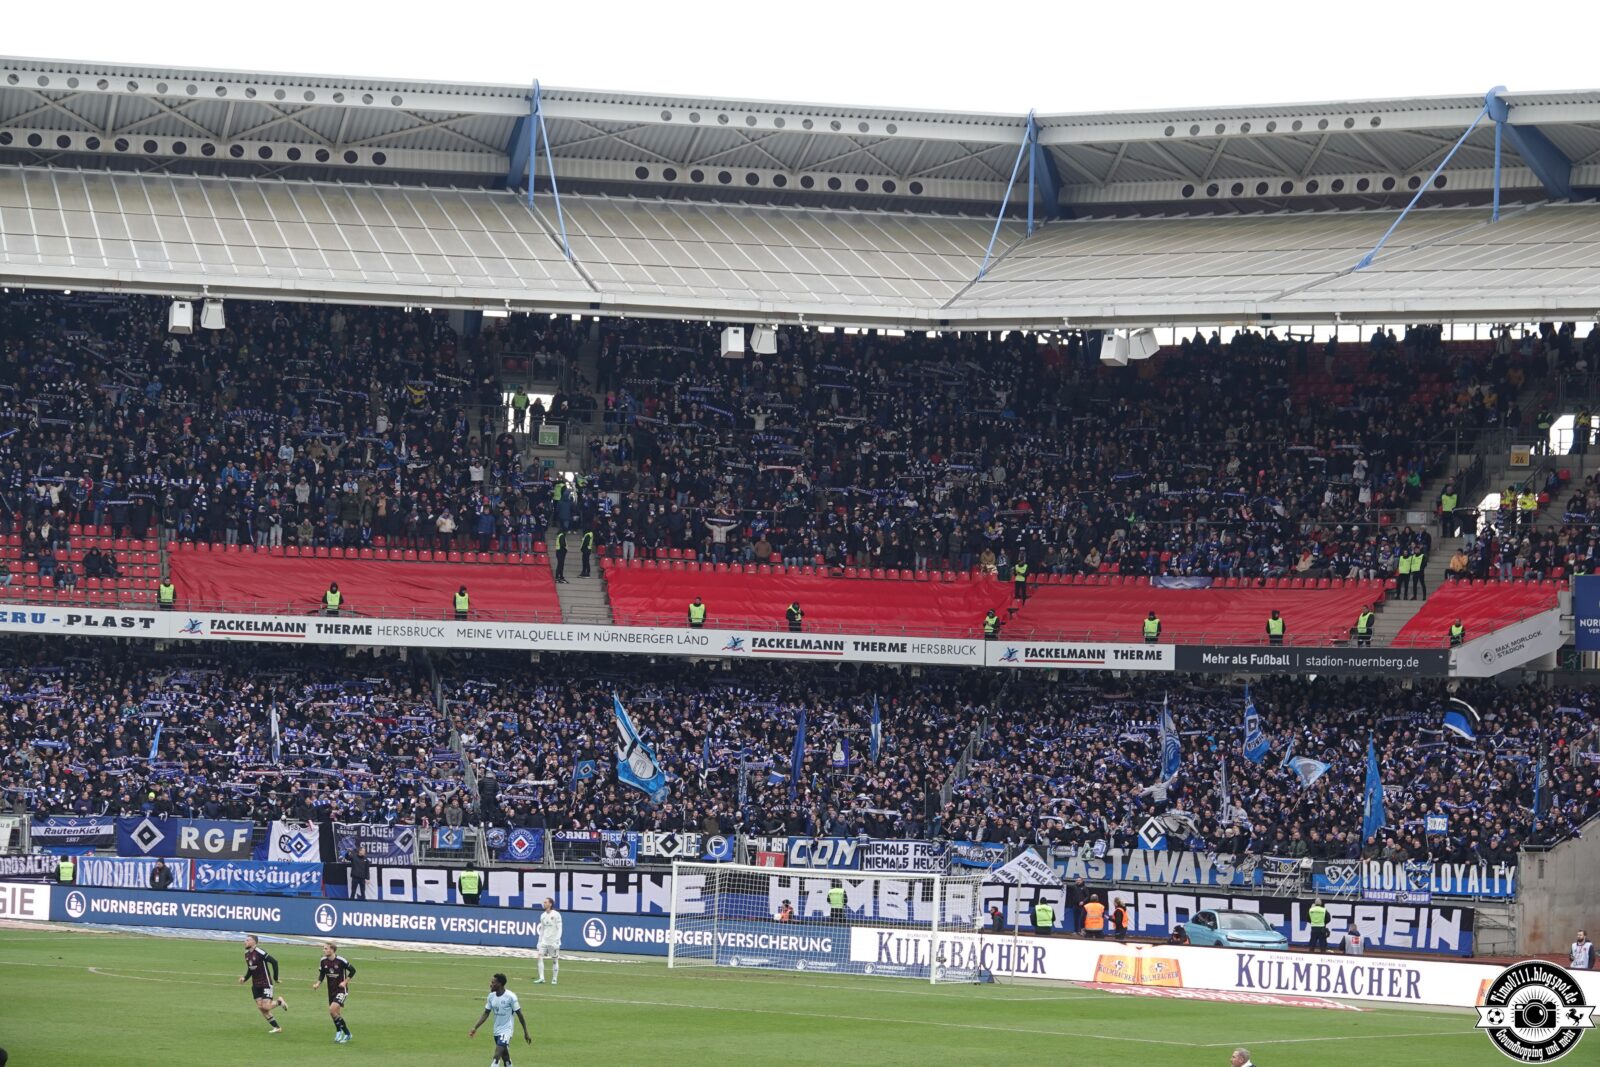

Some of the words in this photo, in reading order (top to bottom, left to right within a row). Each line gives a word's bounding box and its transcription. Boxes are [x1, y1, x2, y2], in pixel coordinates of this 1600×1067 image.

[67, 614, 155, 629] PLAST
[1579, 618, 1600, 627] NÜR
[210, 619, 306, 633] FACKELMANN
[315, 623, 372, 636] THERME
[377, 626, 445, 638] HERSBRUCK
[456, 628, 493, 639] MEINE
[496, 629, 573, 642] VITALQUELLE
[577, 632, 590, 642] IM
[593, 630, 674, 645] NÜRNBERGER
[677, 633, 709, 646] LAND
[1495, 643, 1509, 653] MAX
[1510, 630, 1543, 649] MORLOCK
[751, 637, 844, 651] FACKELMANN
[853, 640, 907, 653] THERME
[912, 643, 977, 656] HERSBRUCK
[1024, 647, 1105, 660] FACKELMANN
[1113, 649, 1162, 661] THERME
[1497, 644, 1525, 658] STADION
[1202, 653, 1229, 665] Mehr
[1232, 654, 1248, 665] als
[1250, 654, 1290, 666] Fußball
[1305, 655, 1419, 670] stadion-nuernberg.de
[44, 826, 101, 835] RautenKick
[866, 843, 909, 856] NIEMALS
[865, 857, 909, 870] NIEMALS
[196, 863, 321, 889] Hafensänger
[1362, 860, 1407, 891] IRON
[1430, 862, 1516, 894] LOYALTY
[90, 898, 177, 917] NÜRNBERGER
[182, 903, 281, 922] VERSICHERUNG
[342, 911, 436, 931] NÜRNBERGER
[716, 931, 832, 952] VERSICHERUNG
[876, 931, 1047, 974] KULMBACHER
[1235, 953, 1421, 999] KULMBACHER
